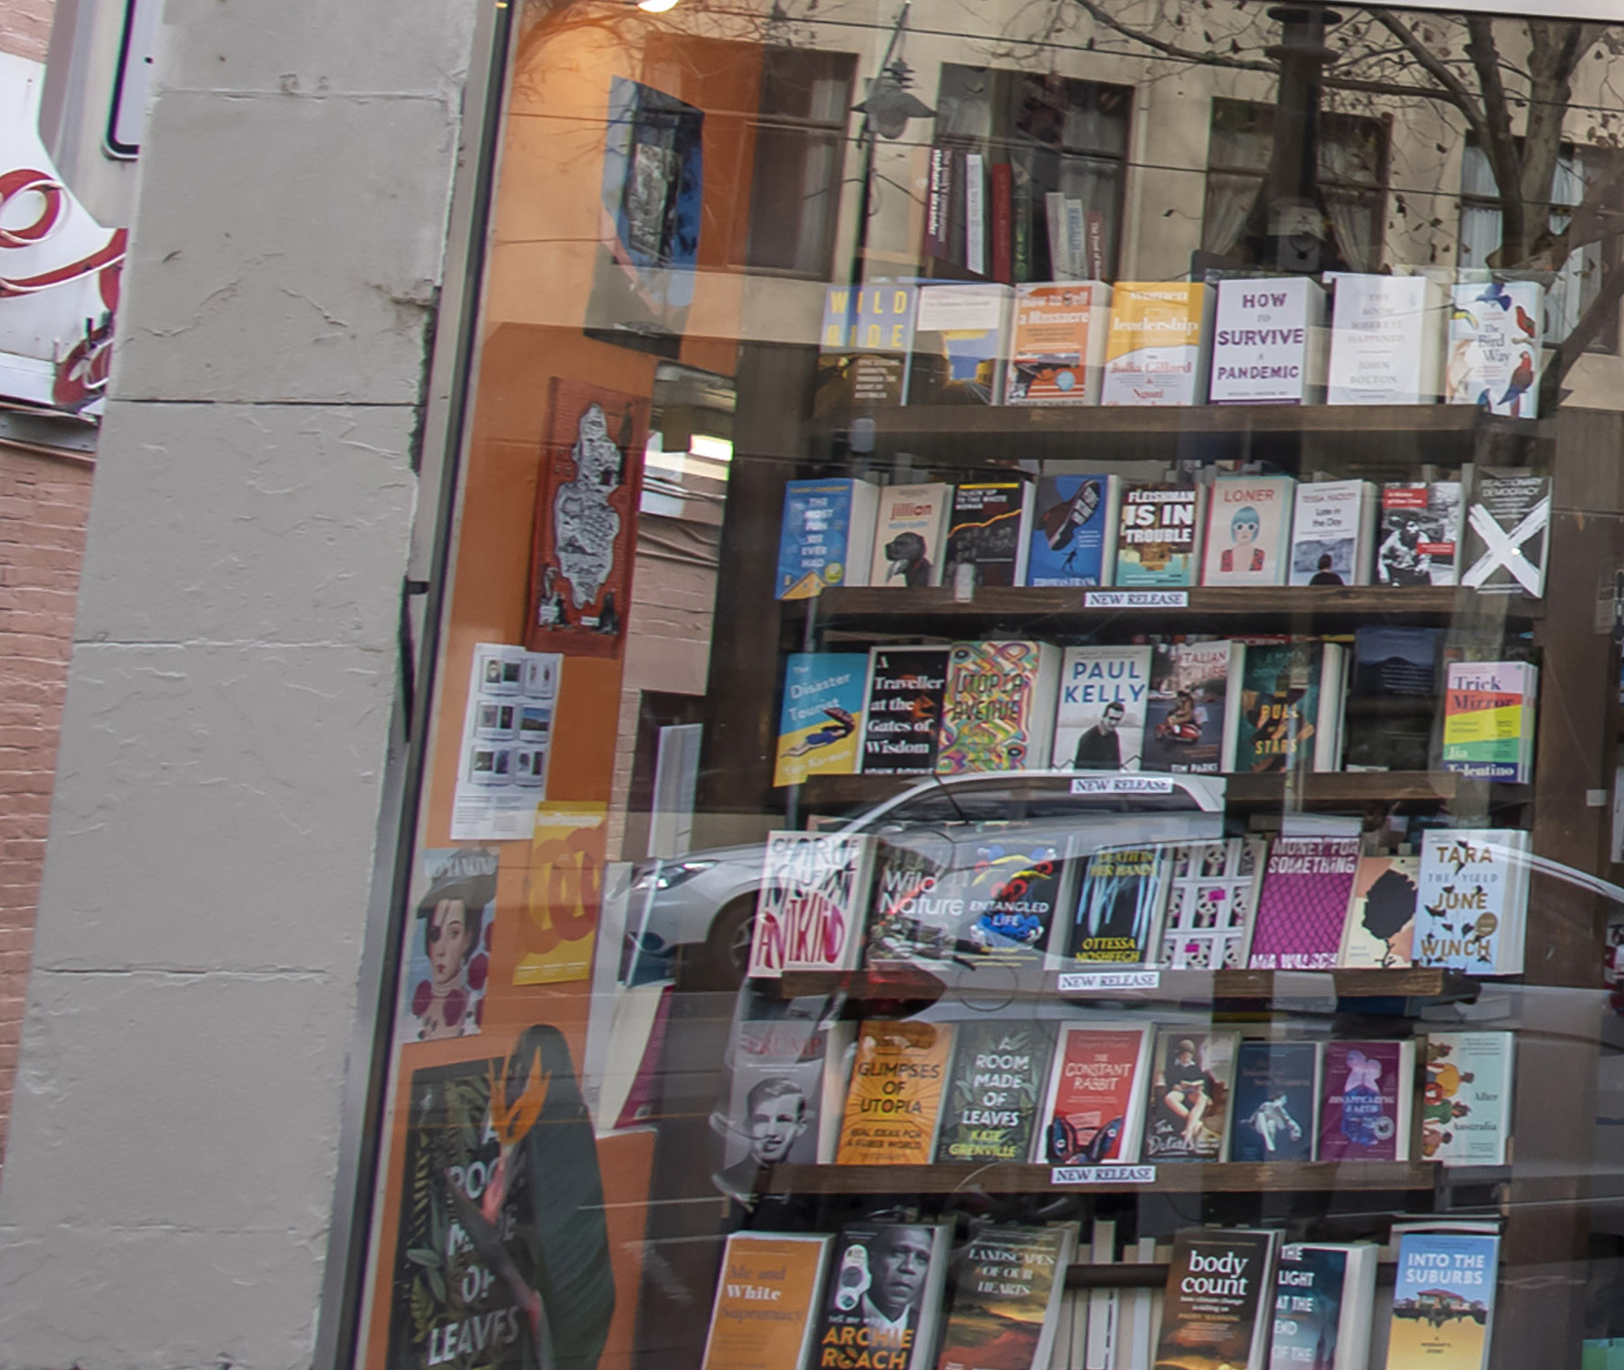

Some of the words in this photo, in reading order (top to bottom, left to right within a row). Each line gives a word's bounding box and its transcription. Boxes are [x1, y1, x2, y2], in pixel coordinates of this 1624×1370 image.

[831, 290, 907, 314] WILD
[1242, 293, 1287, 309] HOW
[1114, 316, 1199, 336] leadership
[827, 324, 904, 348] RIDE
[1217, 329, 1305, 347] SURVIVE
[1477, 333, 1506, 349] Bird
[1217, 365, 1300, 381] PANDEMIC
[1479, 478, 1543, 488] REACTIONARY
[1128, 491, 1196, 503] FLEISHMAN
[1224, 488, 1275, 504] LONER
[1482, 487, 1539, 498] DEMOCRACY
[1125, 505, 1156, 526] IS
[1161, 504, 1194, 525] IN
[1125, 528, 1192, 544] TROUBLE
[1090, 593, 1122, 607] NEW
[1126, 593, 1183, 607] RELEASE
[877, 656, 889, 669] A
[1073, 661, 1141, 680] PAUL
[789, 672, 851, 700] Disaster
[875, 676, 944, 691] Traveller
[1453, 675, 1502, 692] Trick
[1064, 684, 1146, 704] KELLY
[1451, 693, 1515, 711] Mirror
[788, 697, 840, 721] Tourist
[870, 698, 887, 711] at
[889, 696, 914, 711] the
[1260, 703, 1299, 720] PULL
[868, 719, 910, 734] Gates
[913, 718, 932, 733] of
[866, 740, 930, 755] Wisdom
[1255, 739, 1299, 755] STARS
[1449, 746, 1468, 760] Jia
[1445, 762, 1515, 778] Tolentino
[1075, 780, 1108, 792] NEW
[1112, 779, 1170, 792] RELEASE
[1272, 838, 1325, 856] MONEY
[1436, 846, 1494, 864] TARA
[1099, 851, 1138, 863] DEATH
[1267, 856, 1357, 875] SOMETHING
[885, 869, 937, 893] Wild
[1427, 873, 1451, 884] THE
[878, 891, 965, 916] Nature
[968, 900, 1050, 914] ENTANGLED
[1434, 892, 1488, 911] JUNE
[992, 914, 1020, 928] LIFE
[1081, 937, 1137, 951] OTTESSA
[1420, 939, 1492, 958] WINCH
[1062, 975, 1097, 990] NEW
[1099, 973, 1157, 988] RELEASE
[857, 1062, 941, 1079] GLIMPSES
[974, 1055, 1030, 1070] ROOM
[1065, 1061, 1132, 1078] CONSTANT
[882, 1080, 907, 1094] OF
[974, 1073, 1023, 1089] MADE
[1073, 1076, 1119, 1092] RABBIT
[982, 1091, 1007, 1108] OF
[1474, 1091, 1499, 1104] After
[859, 1098, 923, 1116] UTOPIA
[961, 1108, 1020, 1127] LEAVES
[1453, 1120, 1498, 1133] Australia
[948, 1143, 1017, 1159] GRENVILLE
[1055, 1169, 1092, 1183] NEW
[1095, 1166, 1153, 1182] RELEASE
[967, 1247, 1057, 1266] LANDSCAPES
[1280, 1246, 1304, 1261] THE
[1407, 1253, 1452, 1269] INTO
[1454, 1253, 1485, 1270] THE
[755, 1264, 787, 1281] and
[1188, 1248, 1250, 1285] body
[1181, 1273, 1250, 1298] count
[1278, 1270, 1316, 1288] LIGHT
[1404, 1268, 1484, 1286] SUBURBS
[726, 1283, 782, 1302] White
[976, 1281, 1031, 1298] HEARTS
[1291, 1297, 1315, 1313] THE
[820, 1326, 915, 1348] ARCHIE
[1290, 1346, 1314, 1363] THE
